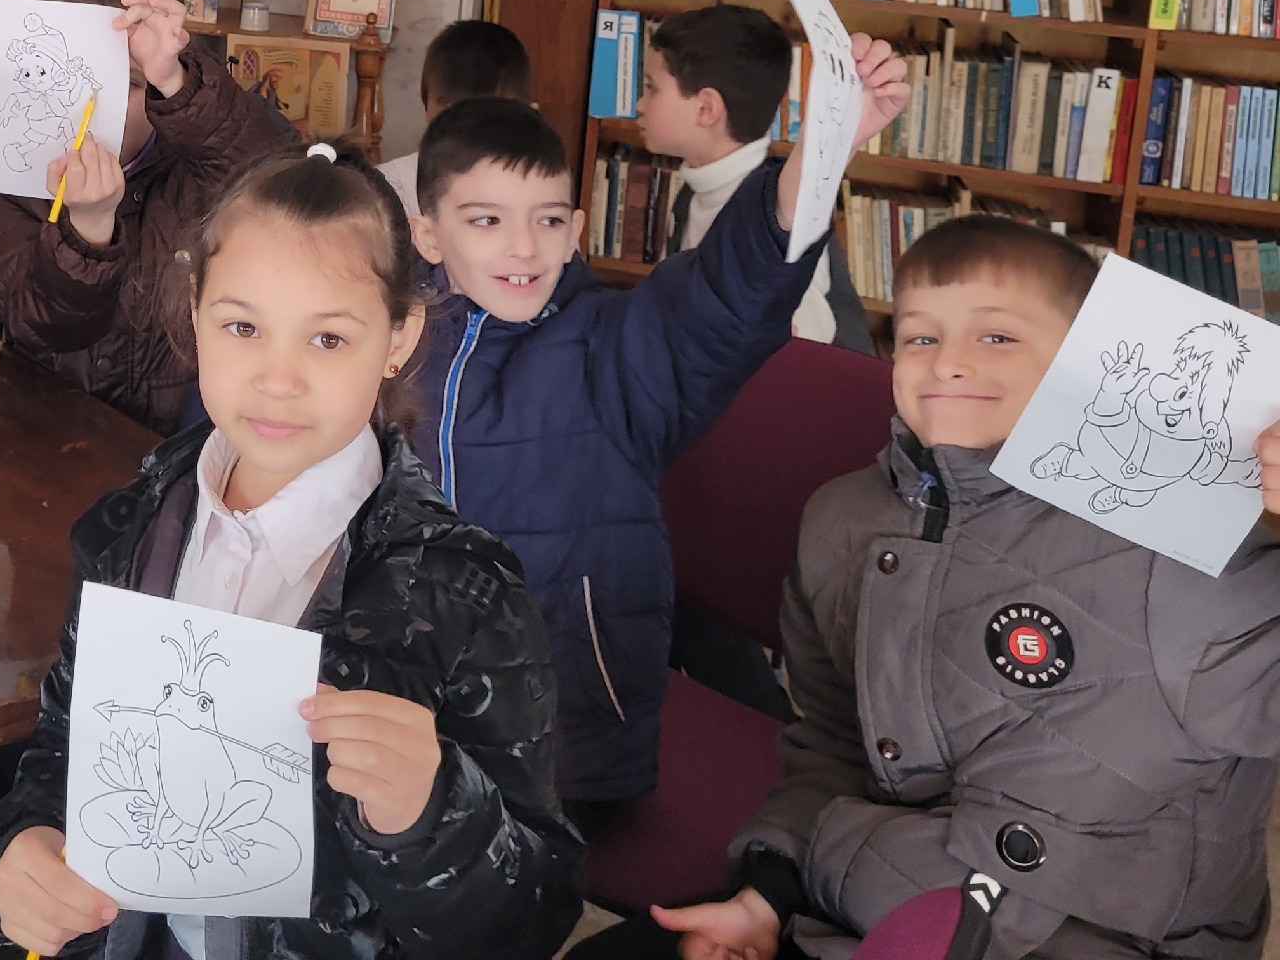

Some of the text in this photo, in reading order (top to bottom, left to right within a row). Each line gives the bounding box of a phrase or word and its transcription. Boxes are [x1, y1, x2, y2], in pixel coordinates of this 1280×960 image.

[602, 21, 614, 32] Я
[1096, 75, 1113, 89] К
[991, 608, 1062, 636] FASHION
